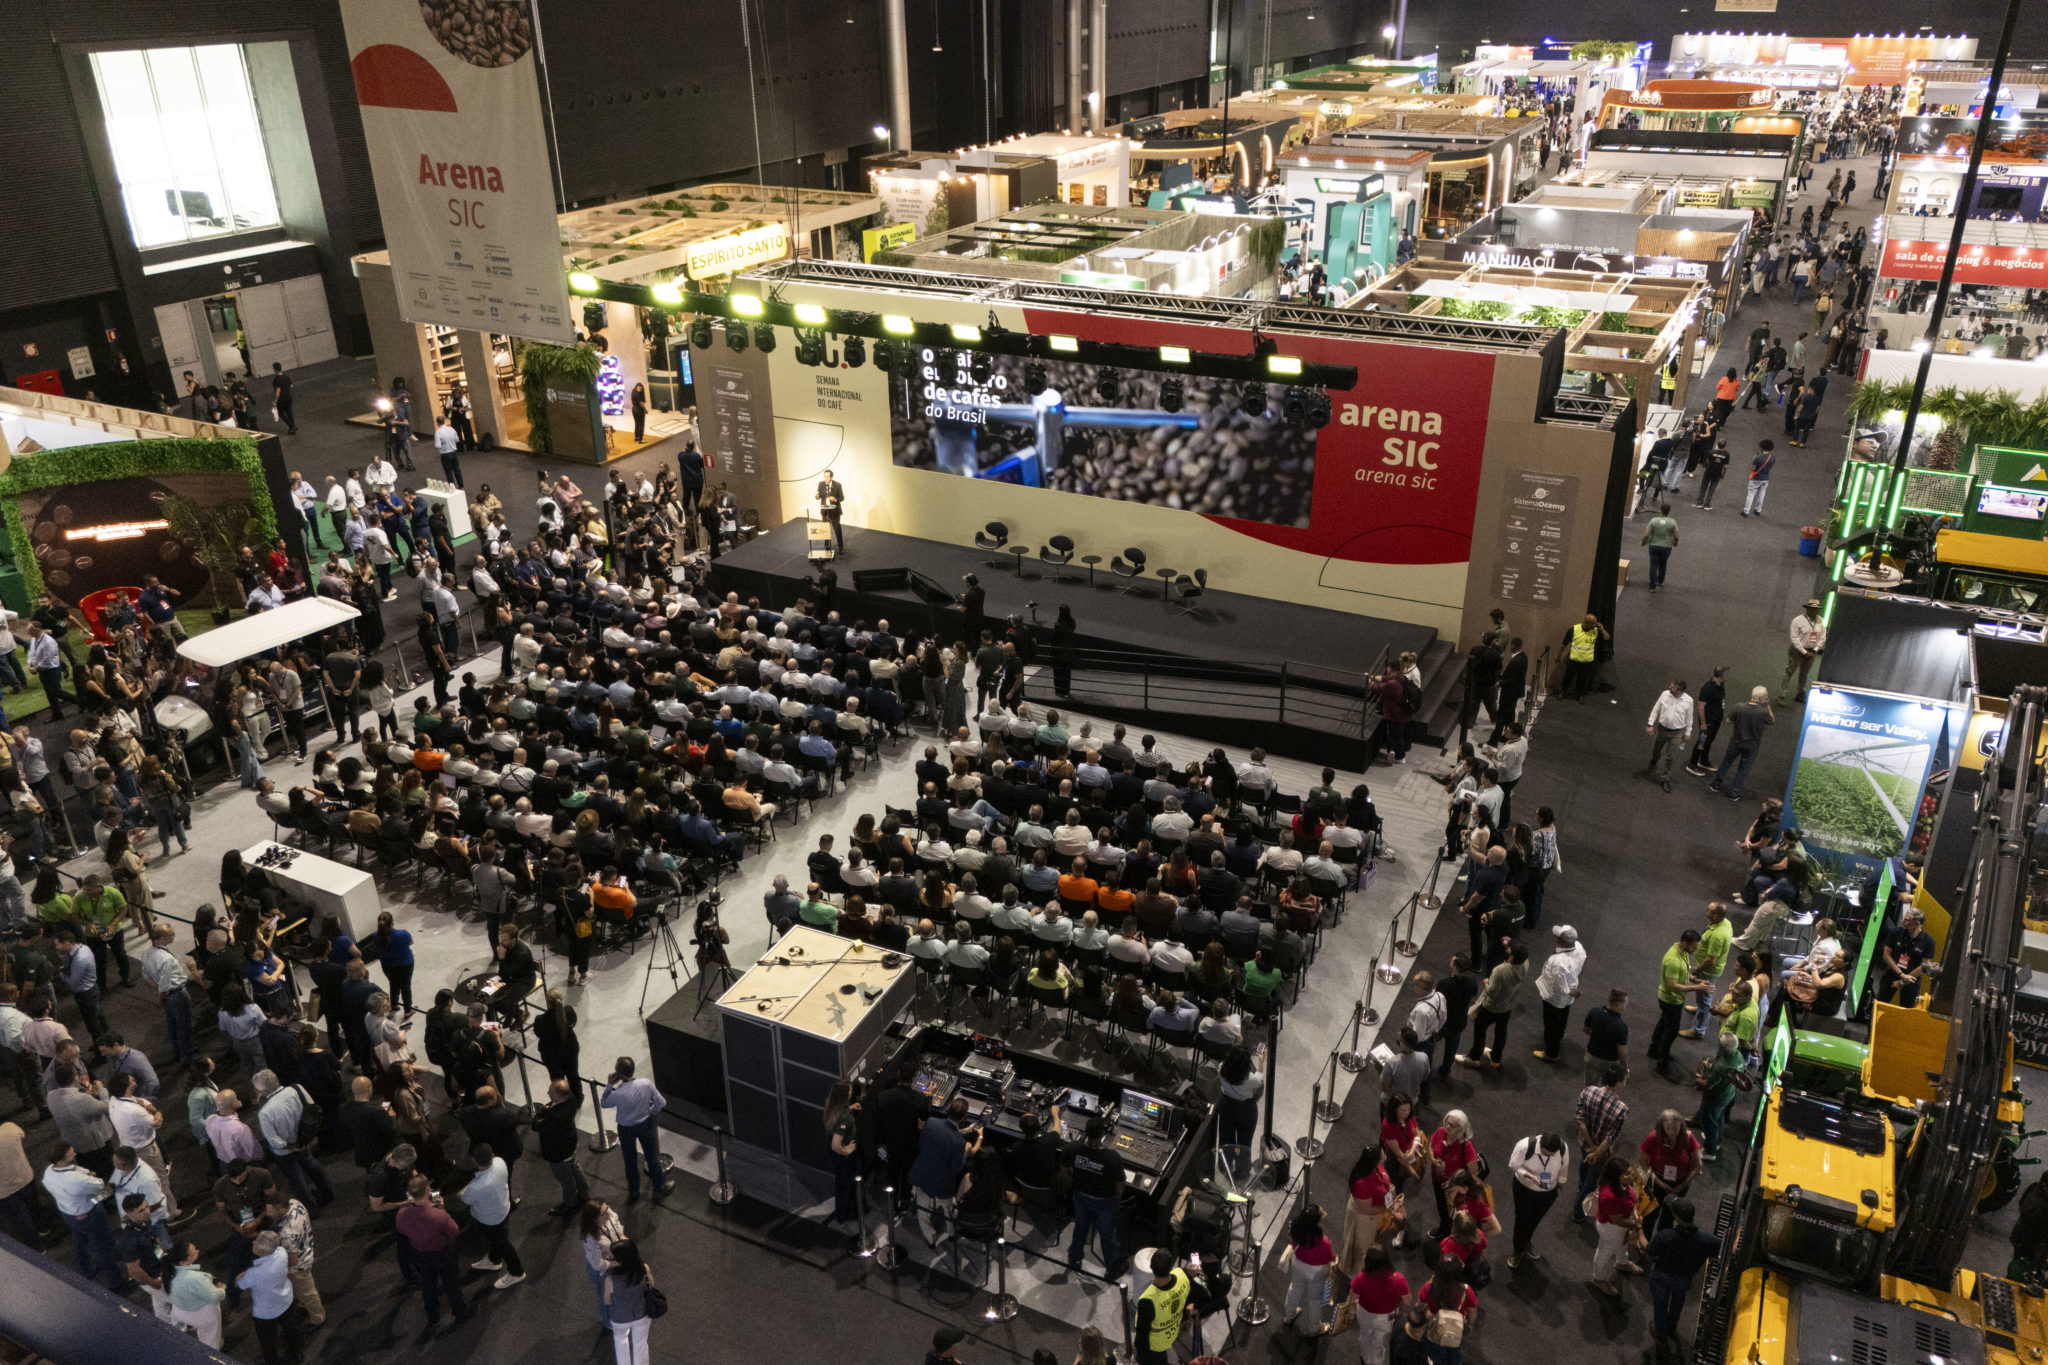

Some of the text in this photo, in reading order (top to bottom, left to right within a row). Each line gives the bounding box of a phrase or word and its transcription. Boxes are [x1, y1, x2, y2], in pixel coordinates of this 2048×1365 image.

[1629, 94, 1664, 106] CRESOL
[419, 153, 504, 193] Arena
[448, 198, 486, 229] SIC
[691, 234, 784, 271] ESPÍRITO SANTO
[1540, 243, 1572, 251] excelência
[1462, 251, 1556, 269] MANHUAÇU
[1895, 252, 2045, 270] sala de cuping & negócios
[922, 349, 934, 363] o
[816, 374, 840, 386] SEMANA
[816, 387, 863, 401] INTERNACIONAL
[818, 398, 843, 411] DO CAFÉ
[924, 381, 1001, 408] de cafés
[925, 402, 987, 425] do Brasil
[1340, 402, 1443, 436] arena
[1382, 437, 1441, 470] SIC
[1354, 468, 1437, 490] arena sic
[1513, 497, 1566, 512] SistemaOcemg
[1811, 711, 1929, 740] Melhor ser Valley.
[1790, 1212, 1858, 1235] JOHN DEERE
